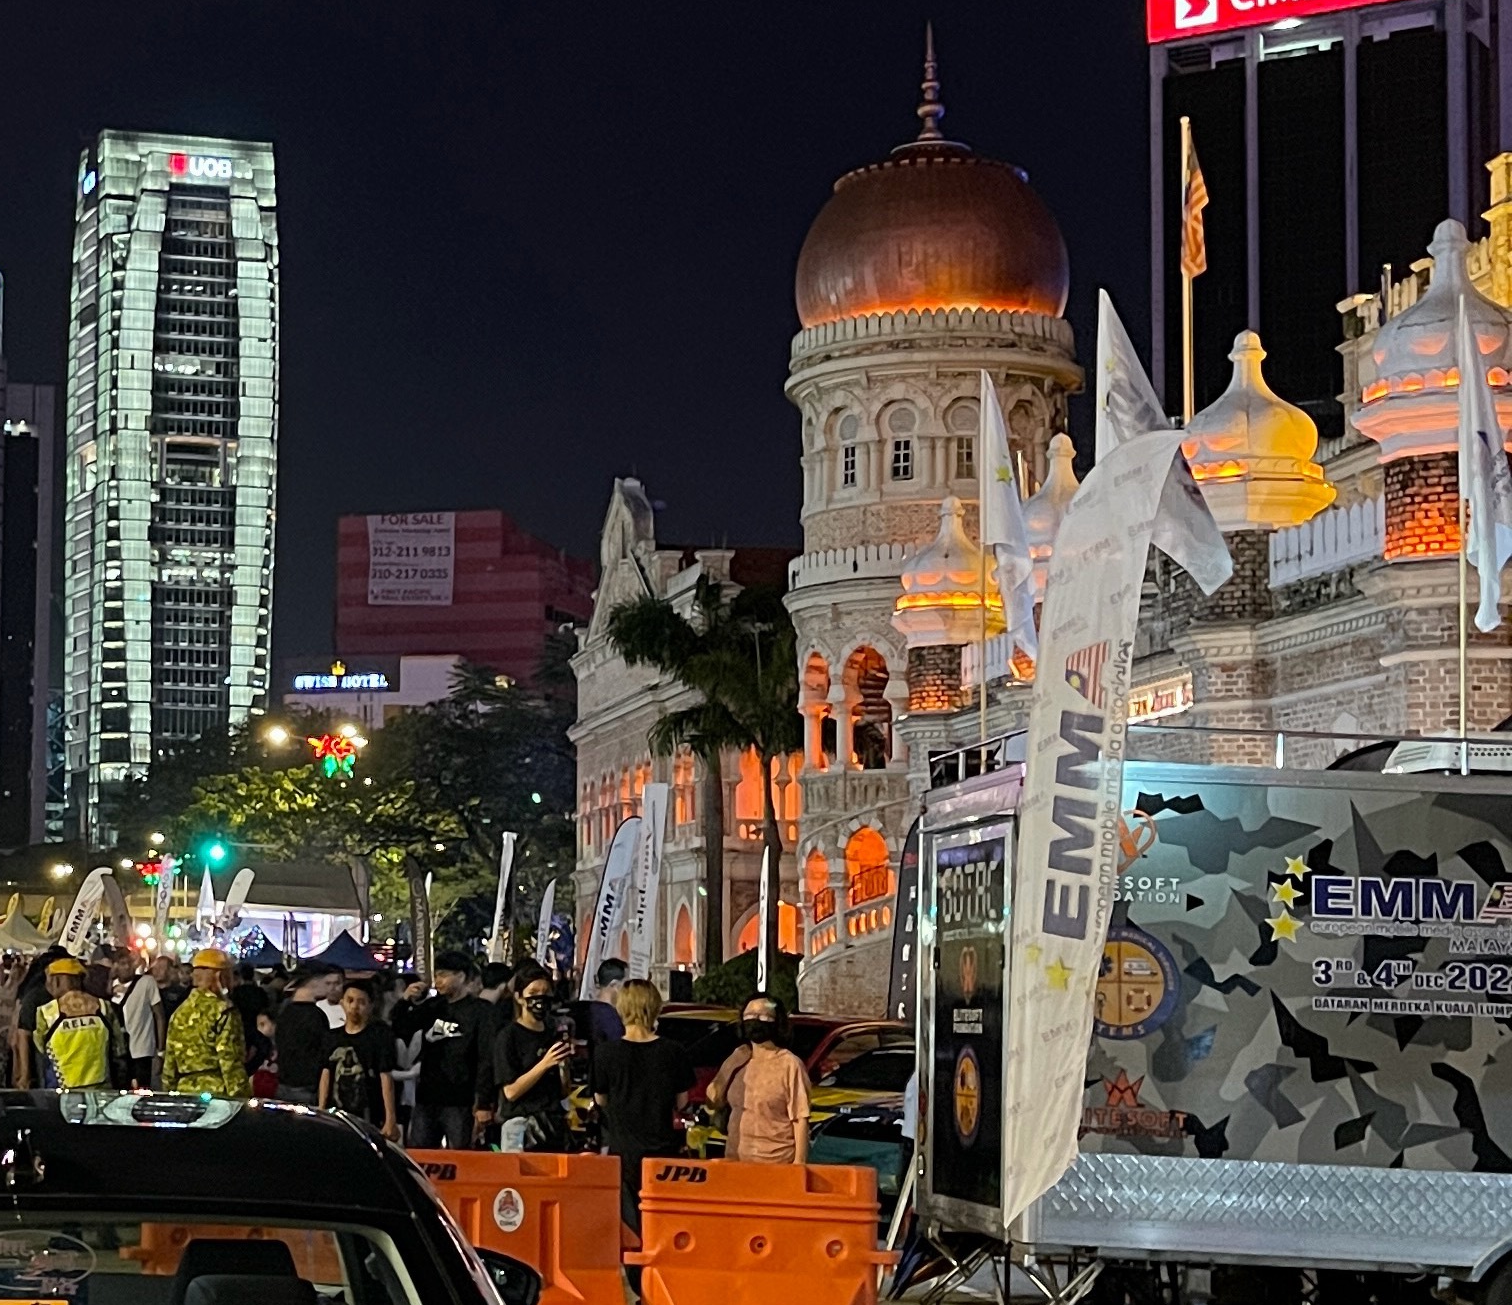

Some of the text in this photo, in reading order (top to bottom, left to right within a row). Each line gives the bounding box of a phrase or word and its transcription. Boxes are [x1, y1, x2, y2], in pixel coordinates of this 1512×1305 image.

[189, 157, 232, 177] UOB
[381, 514, 444, 525] FOR SALE
[341, 673, 389, 688] HOTEL
[1100, 800, 1117, 858] mobile
[1114, 875, 1180, 890] ESOFT
[1113, 890, 1180, 904] DATION
[1311, 922, 1374, 936] european
[1376, 922, 1418, 937] mobile
[1420, 923, 1461, 938] media
[1356, 972, 1372, 986] &
[1413, 973, 1444, 989] DEC
[1447, 963, 1512, 993] 202
[1313, 997, 1369, 1011] DATARAN
[1372, 999, 1432, 1013] MERDEKA
[1434, 1001, 1476, 1015] KUALA
[62, 1018, 96, 1030] RELA
[1084, 1107, 1186, 1127] ITESOFT
